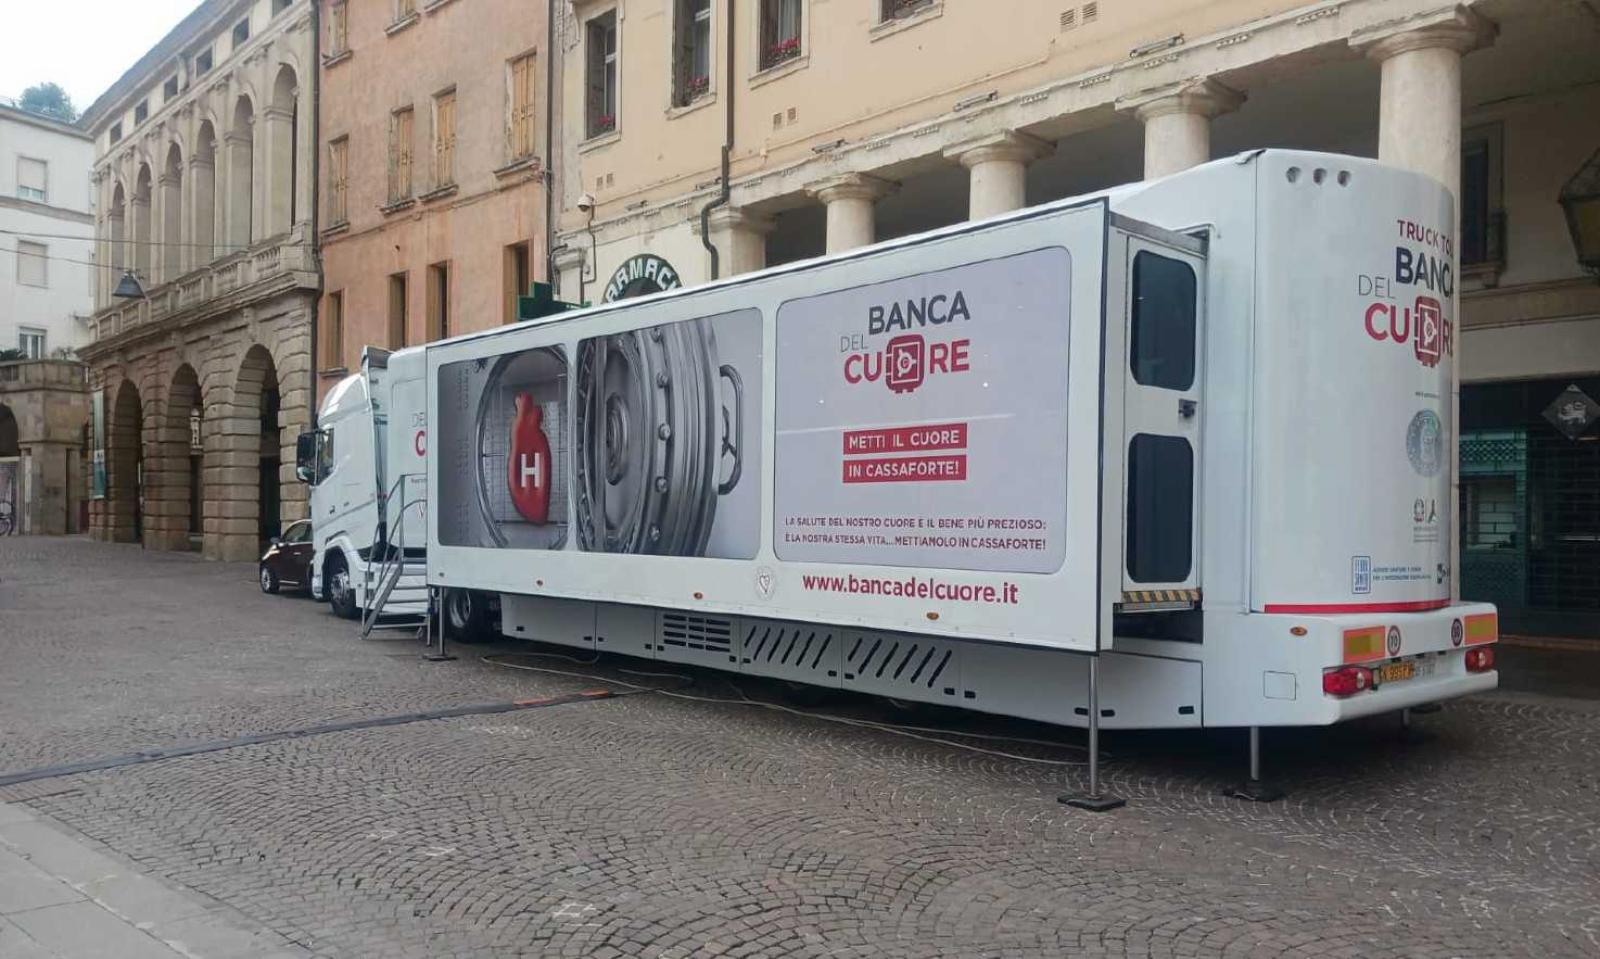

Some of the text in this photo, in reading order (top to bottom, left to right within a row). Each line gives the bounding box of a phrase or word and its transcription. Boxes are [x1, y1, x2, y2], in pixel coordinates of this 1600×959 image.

[1397, 219, 1439, 249] TRUCK
[1358, 274, 1396, 299] DEL
[868, 290, 971, 336] BANCA
[840, 333, 869, 353] DEL
[843, 334, 971, 394] CUORE
[849, 430, 960, 450] METTI IL CUORE
[521, 452, 540, 488] H
[849, 460, 960, 478] IN CASSAFORTE!
[785, 517, 795, 526] LA
[797, 517, 826, 527] SALUTE
[828, 517, 844, 527] DEL
[846, 517, 881, 527] NOSTRO
[883, 518, 915, 528] CUORE
[927, 518, 935, 528] IL
[938, 518, 965, 528] BENE
[987, 519, 1047, 530] PREZIOSO:
[791, 534, 801, 543] LA
[802, 534, 833, 544] NOSTRA
[834, 535, 865, 545] STESSA
[958, 537, 969, 548] IN
[971, 538, 1047, 550] CASSAFORTE!
[802, 574, 1019, 605] www.bancadelcuore.it
